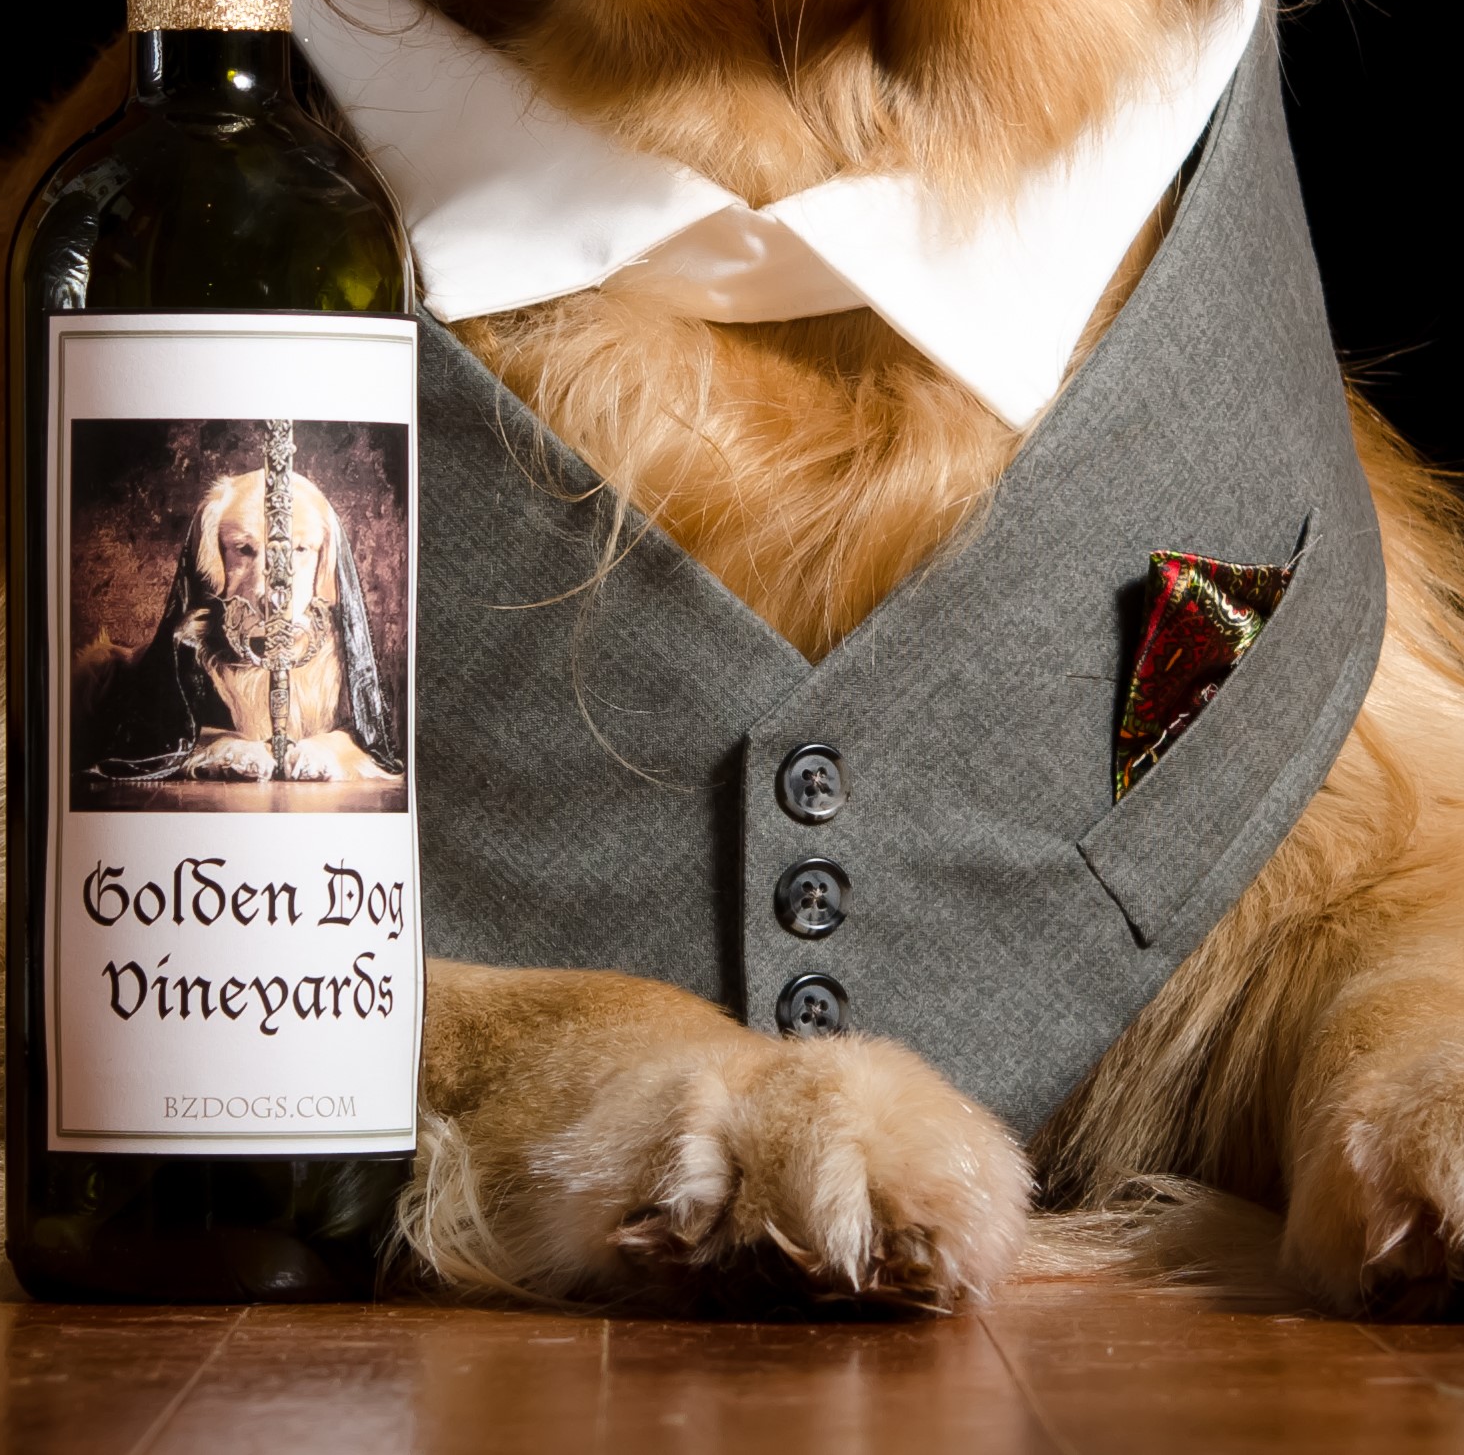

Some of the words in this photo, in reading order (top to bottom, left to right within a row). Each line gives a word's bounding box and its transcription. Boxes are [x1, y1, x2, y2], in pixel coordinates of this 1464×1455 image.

[83, 857, 303, 927] Golden
[317, 858, 404, 940] Dog
[102, 951, 393, 1036] Vineyards
[163, 1095, 357, 1120] BZDOGS.COM
